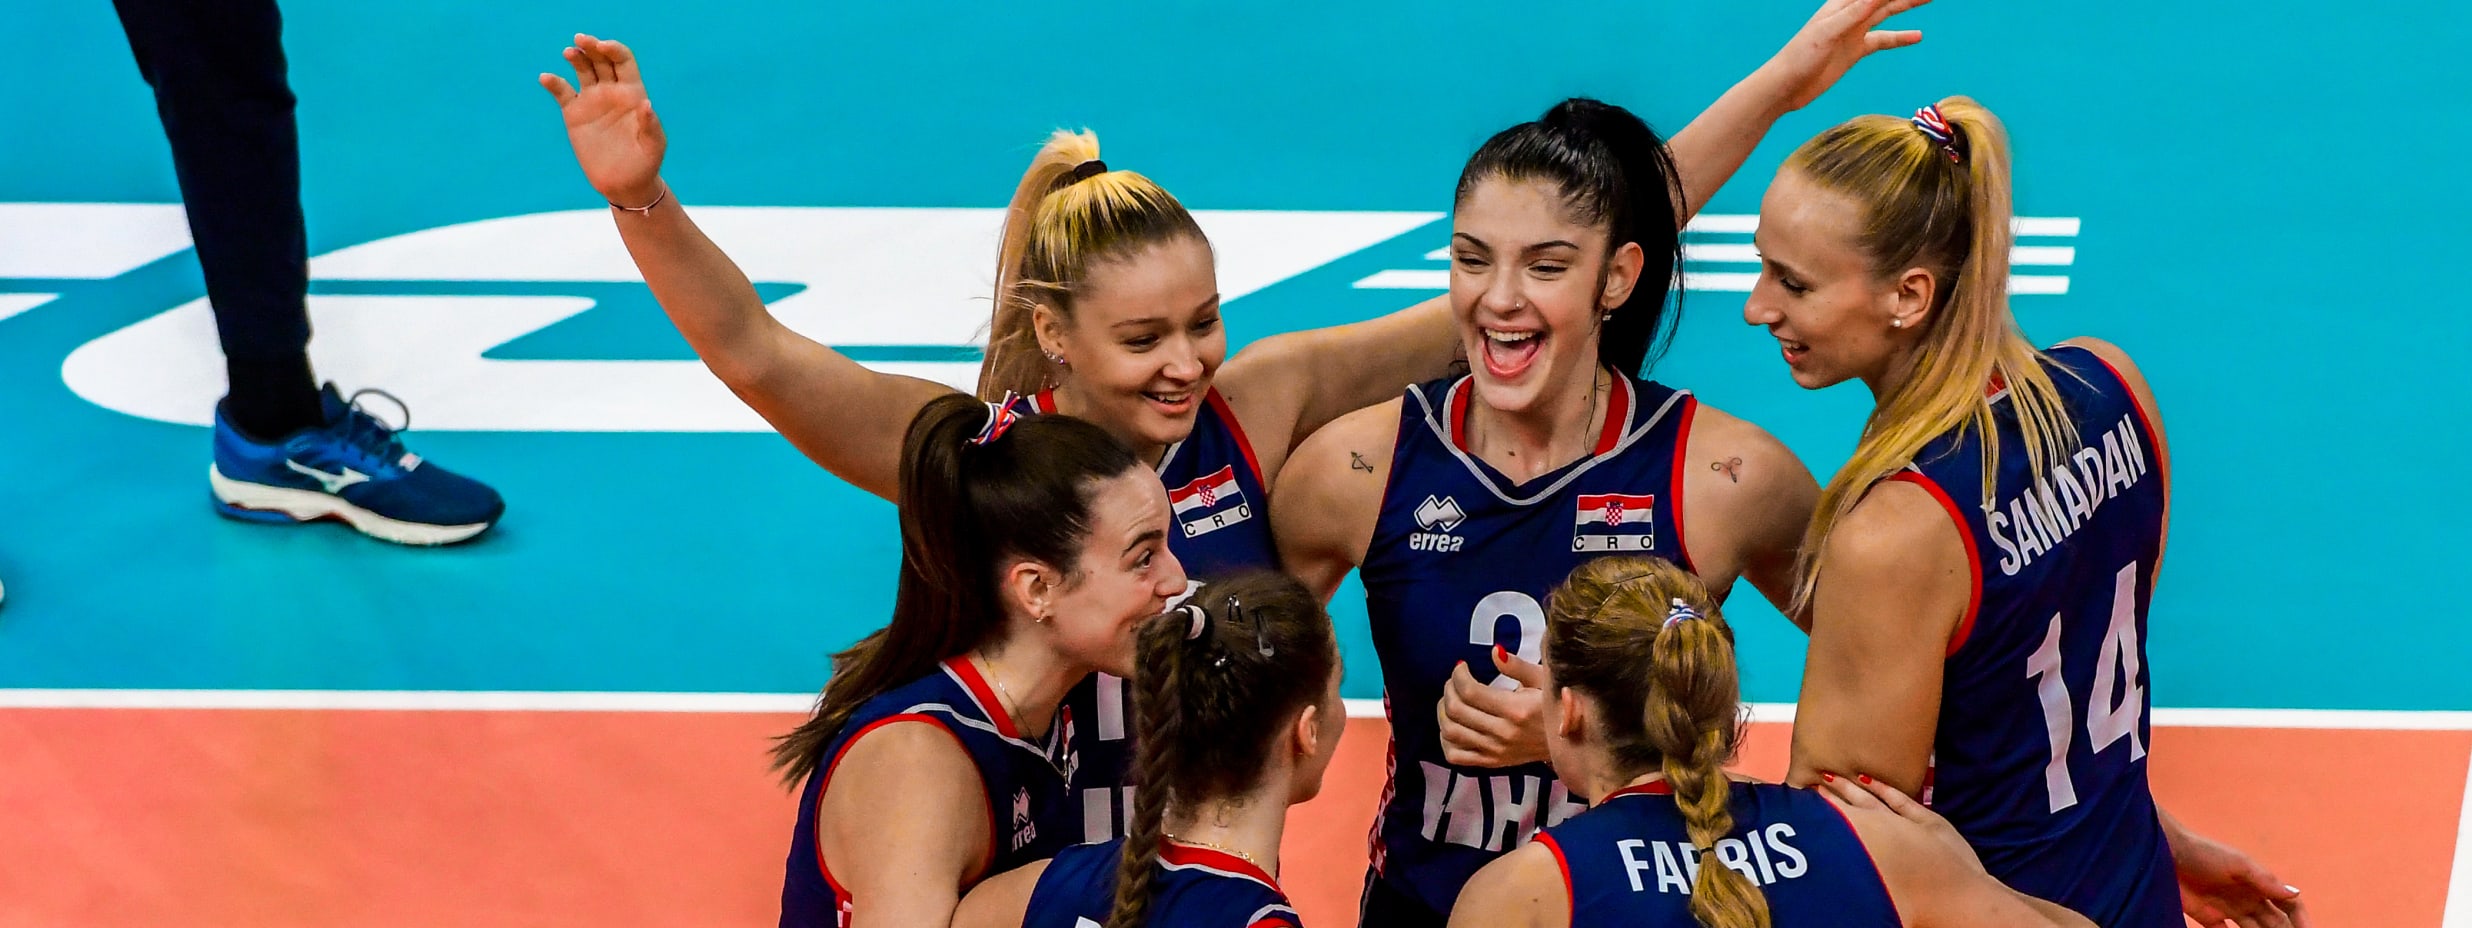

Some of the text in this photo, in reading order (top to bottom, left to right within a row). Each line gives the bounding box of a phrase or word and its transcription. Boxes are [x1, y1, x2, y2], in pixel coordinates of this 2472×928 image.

[1184, 505, 1249, 536] CRO
[1573, 536, 1654, 551] CRO
[2027, 560, 2146, 814] 14
